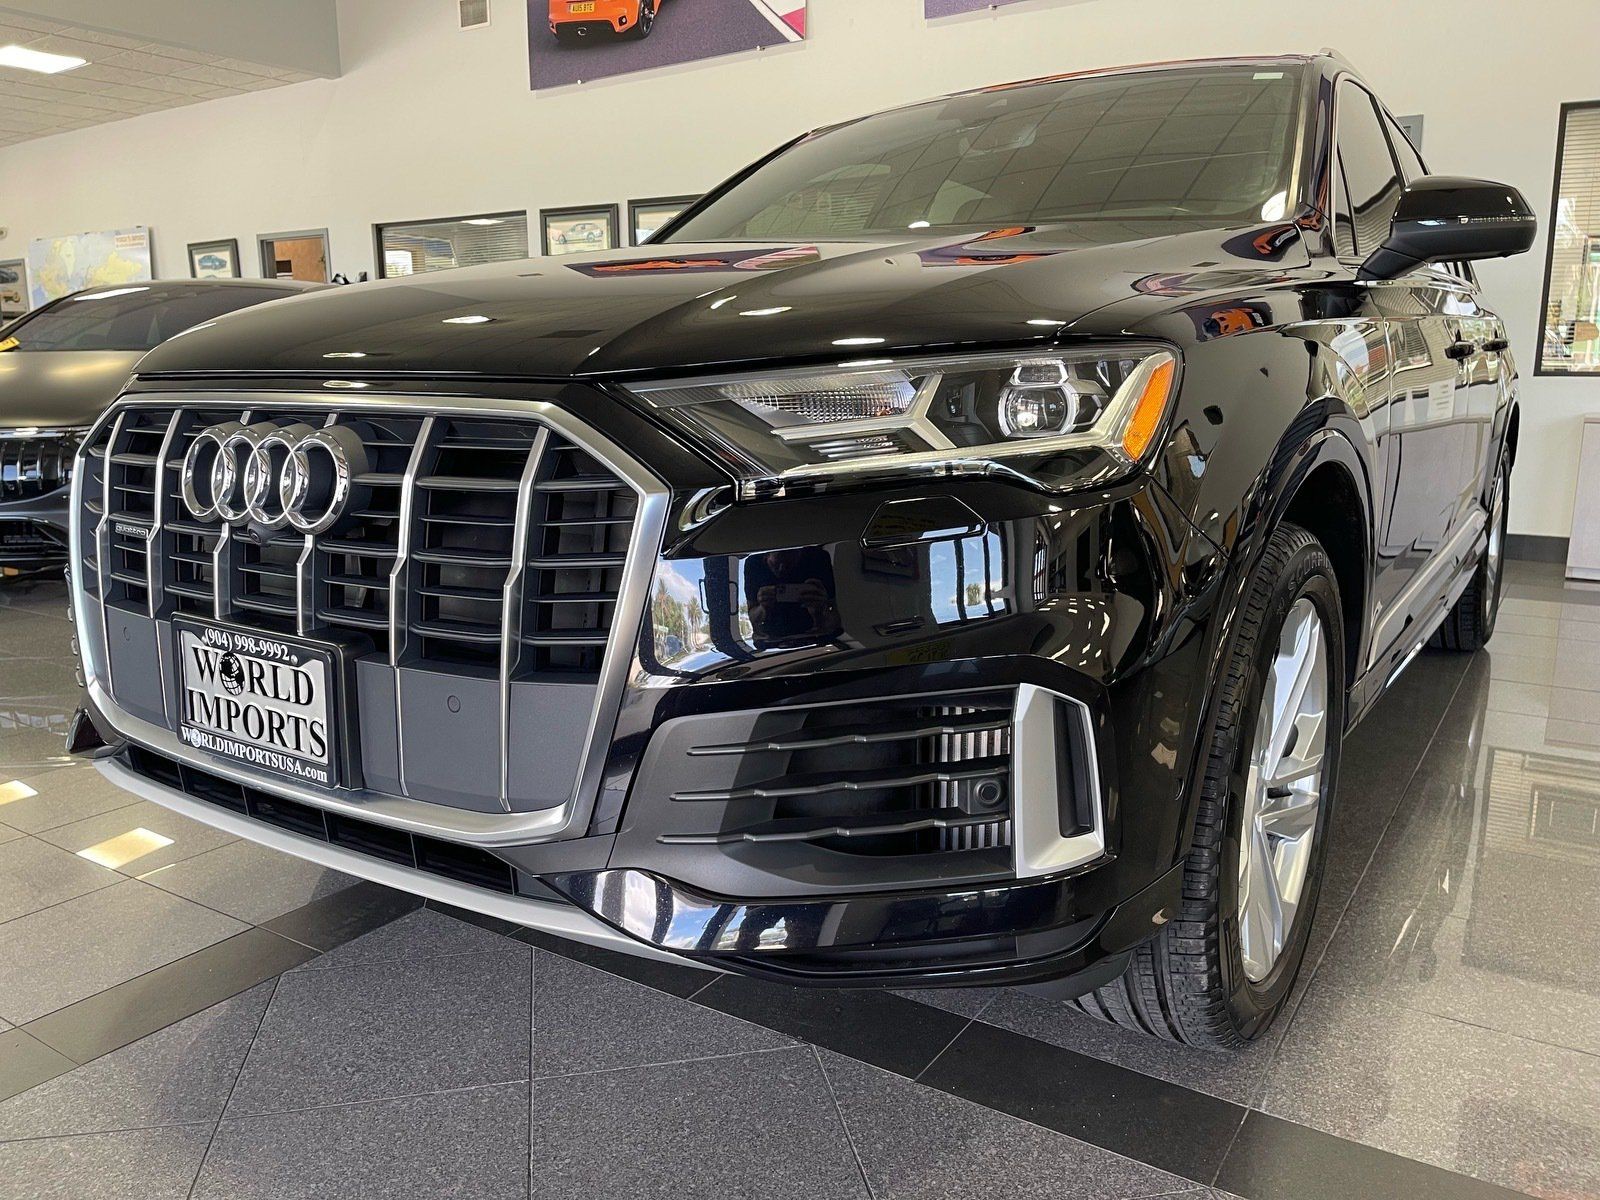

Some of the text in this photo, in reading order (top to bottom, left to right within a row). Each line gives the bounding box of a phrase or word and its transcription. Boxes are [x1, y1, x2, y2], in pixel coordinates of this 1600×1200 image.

[115, 525, 146, 536] quattro
[204, 628, 290, 661] (904) 998-9992
[192, 646, 315, 706] WORLD
[187, 689, 326, 758] IMPORTS
[181, 727, 328, 783] WORLDIMPORTSUSA.com
